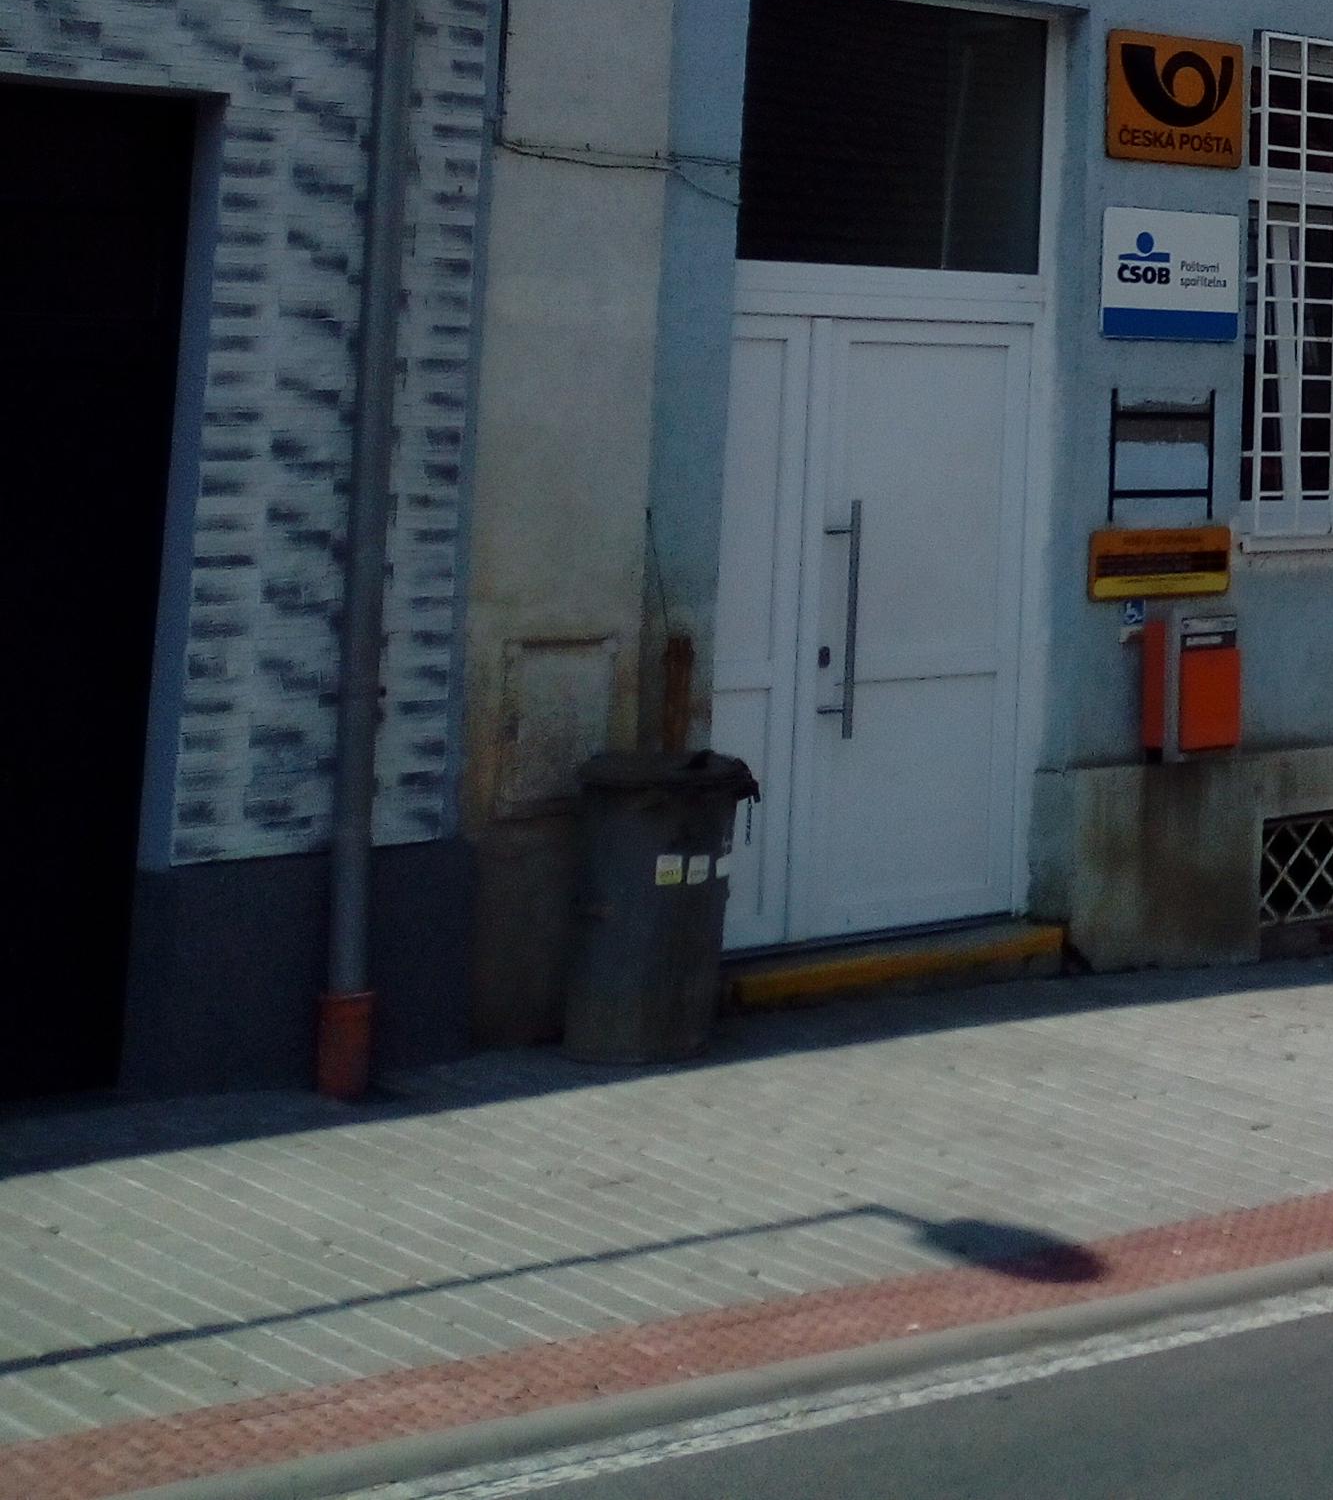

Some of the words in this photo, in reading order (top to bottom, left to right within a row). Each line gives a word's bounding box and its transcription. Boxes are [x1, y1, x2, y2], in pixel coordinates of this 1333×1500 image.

[1119, 125, 1174, 149] ČESKÁ
[1179, 132, 1233, 154] POŠTA
[1117, 263, 1170, 284] ČSOB
